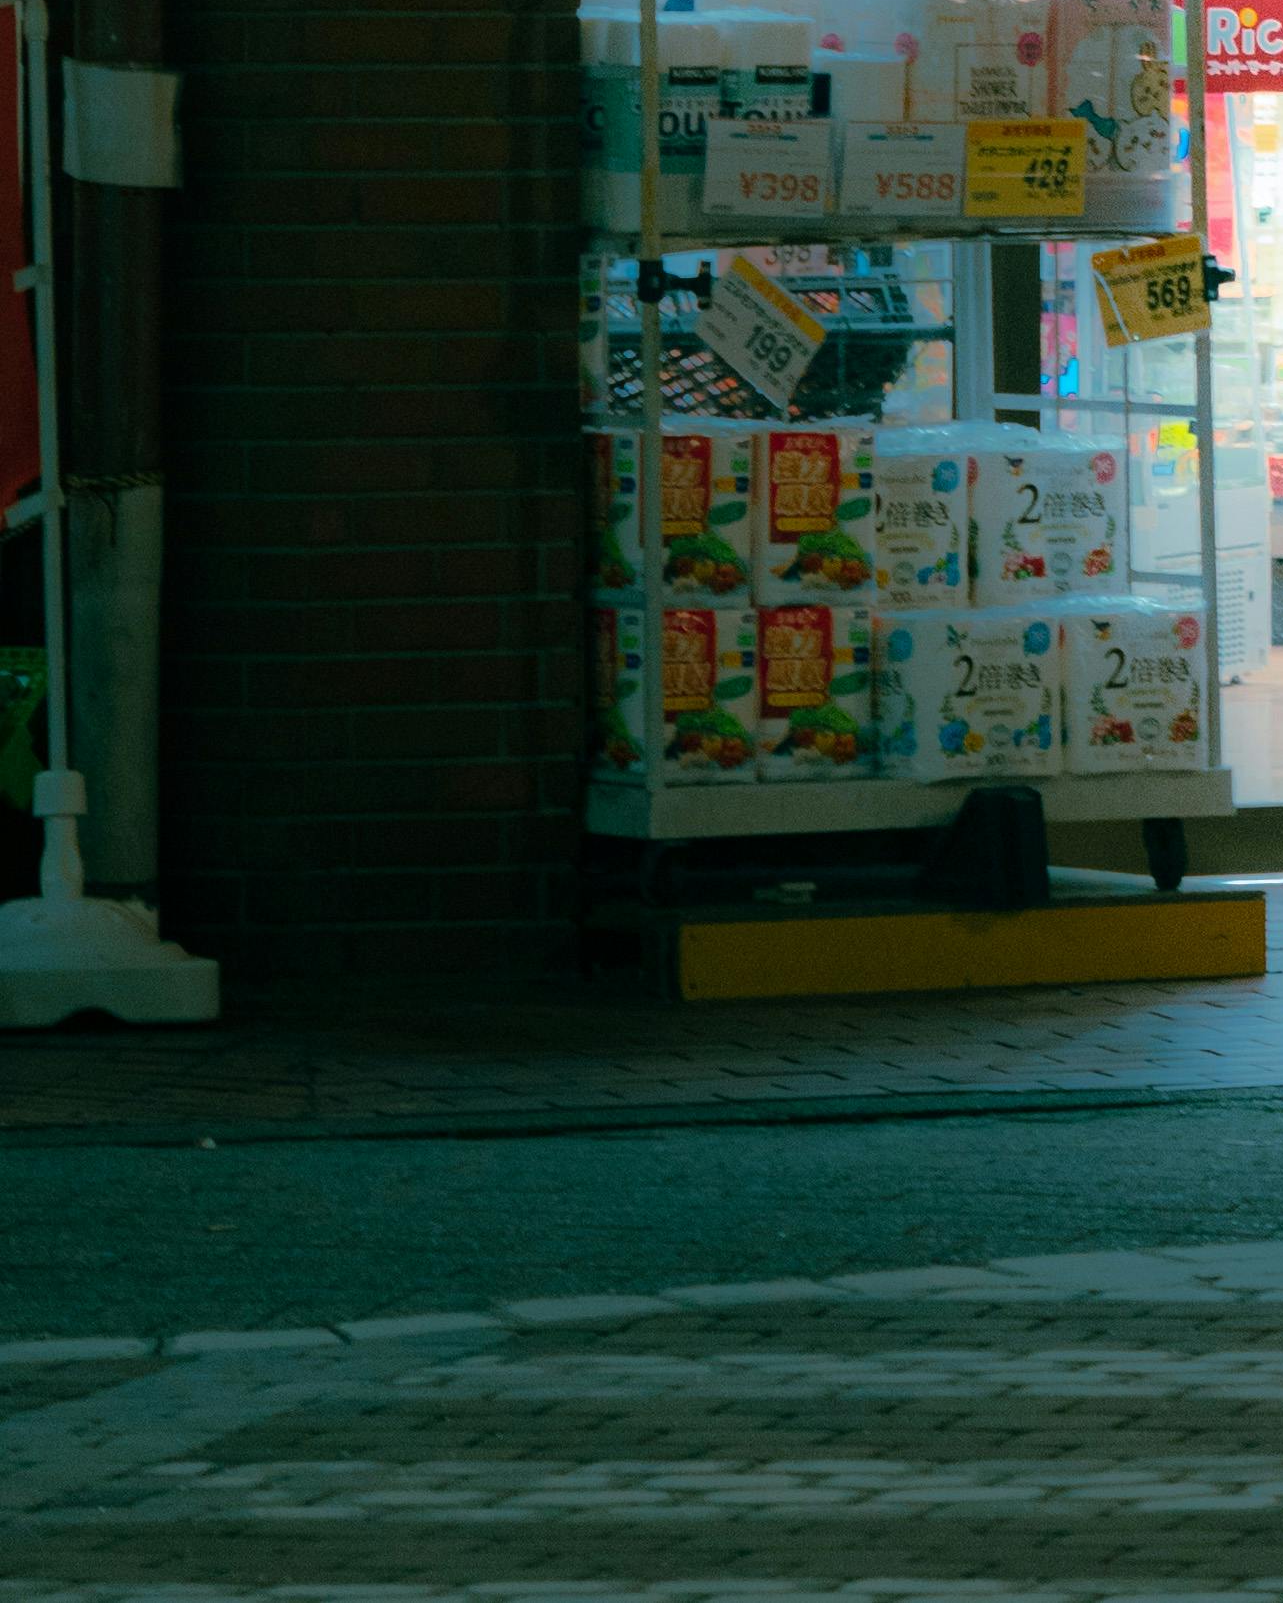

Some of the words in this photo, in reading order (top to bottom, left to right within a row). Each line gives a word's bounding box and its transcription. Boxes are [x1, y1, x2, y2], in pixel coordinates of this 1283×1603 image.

[741, 172, 820, 202] ¥398
[876, 172, 956, 201] ¥588
[1024, 159, 1070, 189] 428
[1147, 275, 1191, 312] 569
[744, 324, 792, 373] 199
